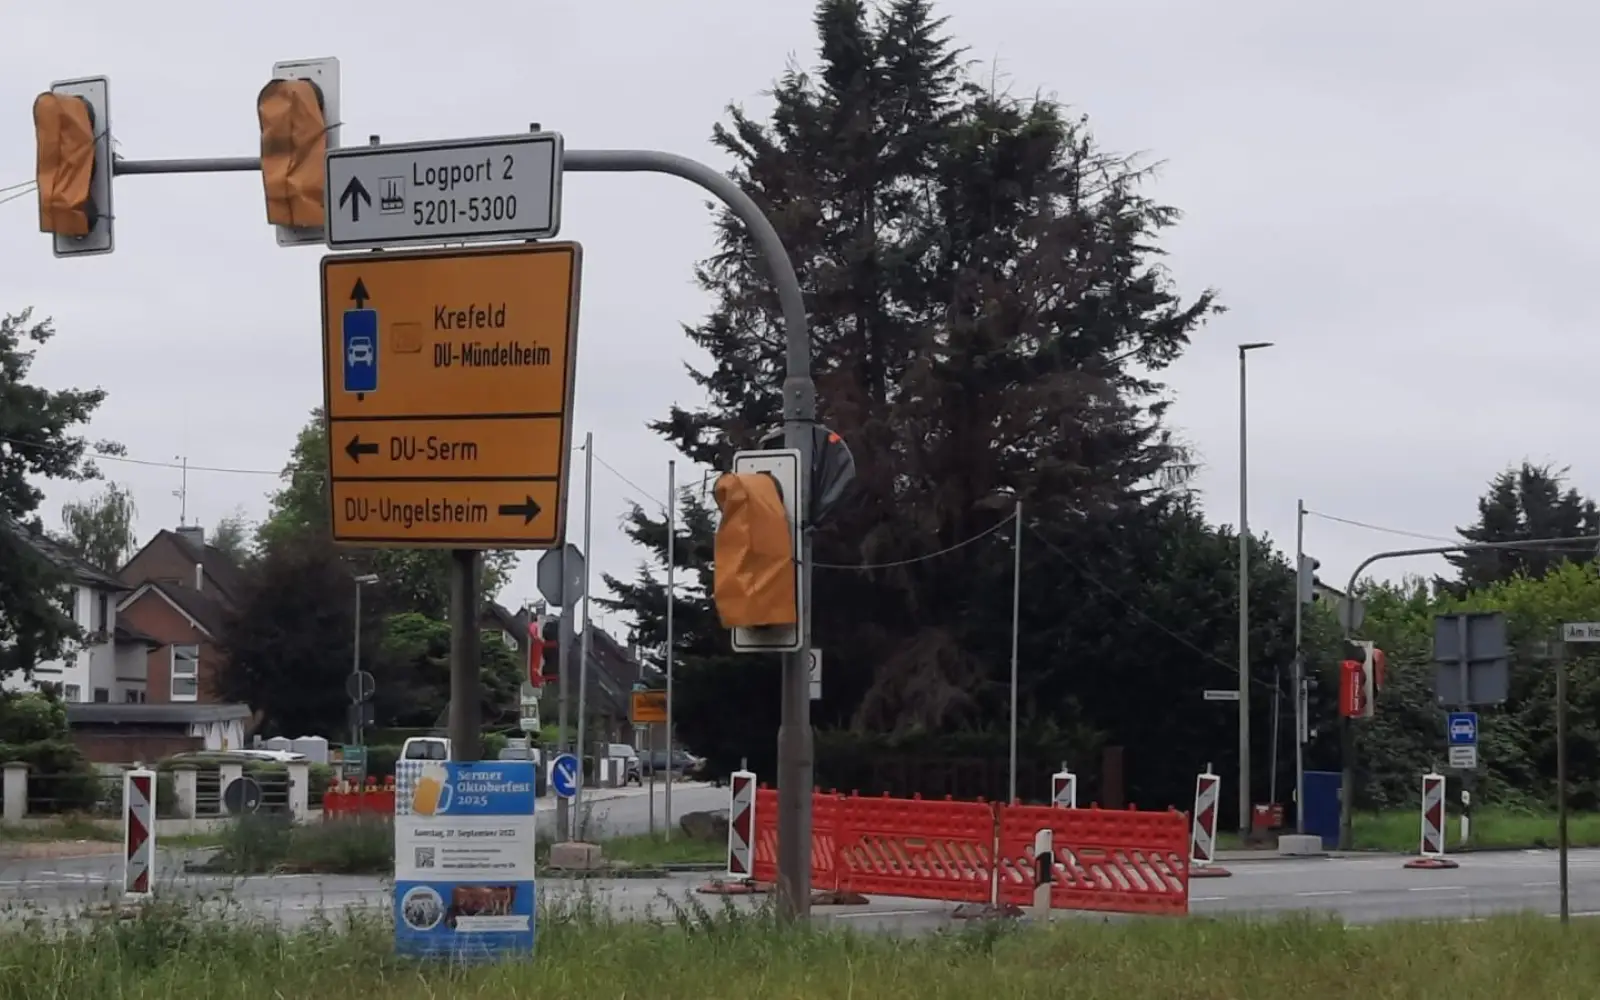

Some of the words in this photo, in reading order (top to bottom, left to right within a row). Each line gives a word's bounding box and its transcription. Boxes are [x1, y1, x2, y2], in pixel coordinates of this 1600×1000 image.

[412, 157, 493, 191] Logport
[502, 154, 514, 181] 2
[413, 195, 517, 226] 5201-5300
[434, 303, 506, 330] Krefeld
[434, 340, 551, 368] DU-Mündelheim
[390, 436, 478, 461] DU-Serm
[344, 496, 488, 529] DU-Ungelsheim
[457, 770, 503, 781] Sermer
[457, 780, 531, 793] Oktoberfest
[457, 796, 488, 807] 2025
